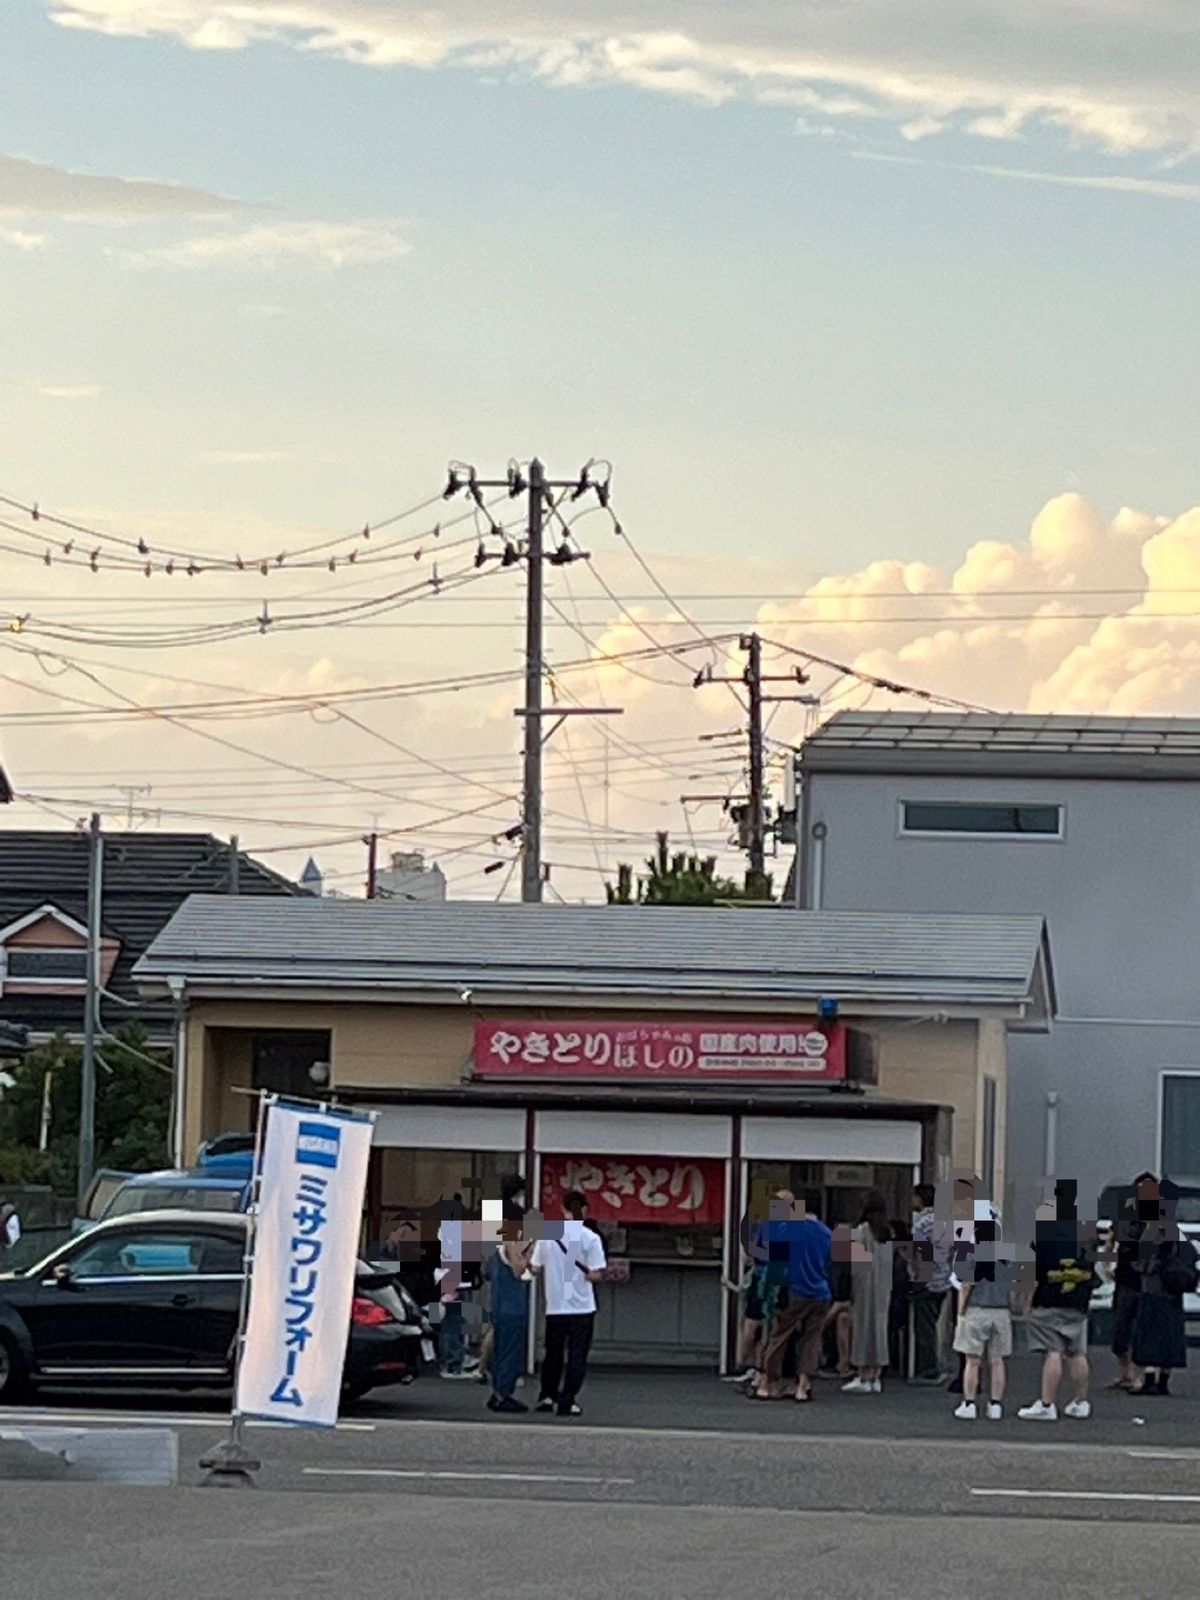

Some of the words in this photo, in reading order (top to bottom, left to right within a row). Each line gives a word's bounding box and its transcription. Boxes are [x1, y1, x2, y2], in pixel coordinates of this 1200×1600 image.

[490, 1031, 611, 1064] やきとり
[559, 1160, 705, 1210] やきとり
[270, 1174, 328, 1407] ミサワリフォーム
